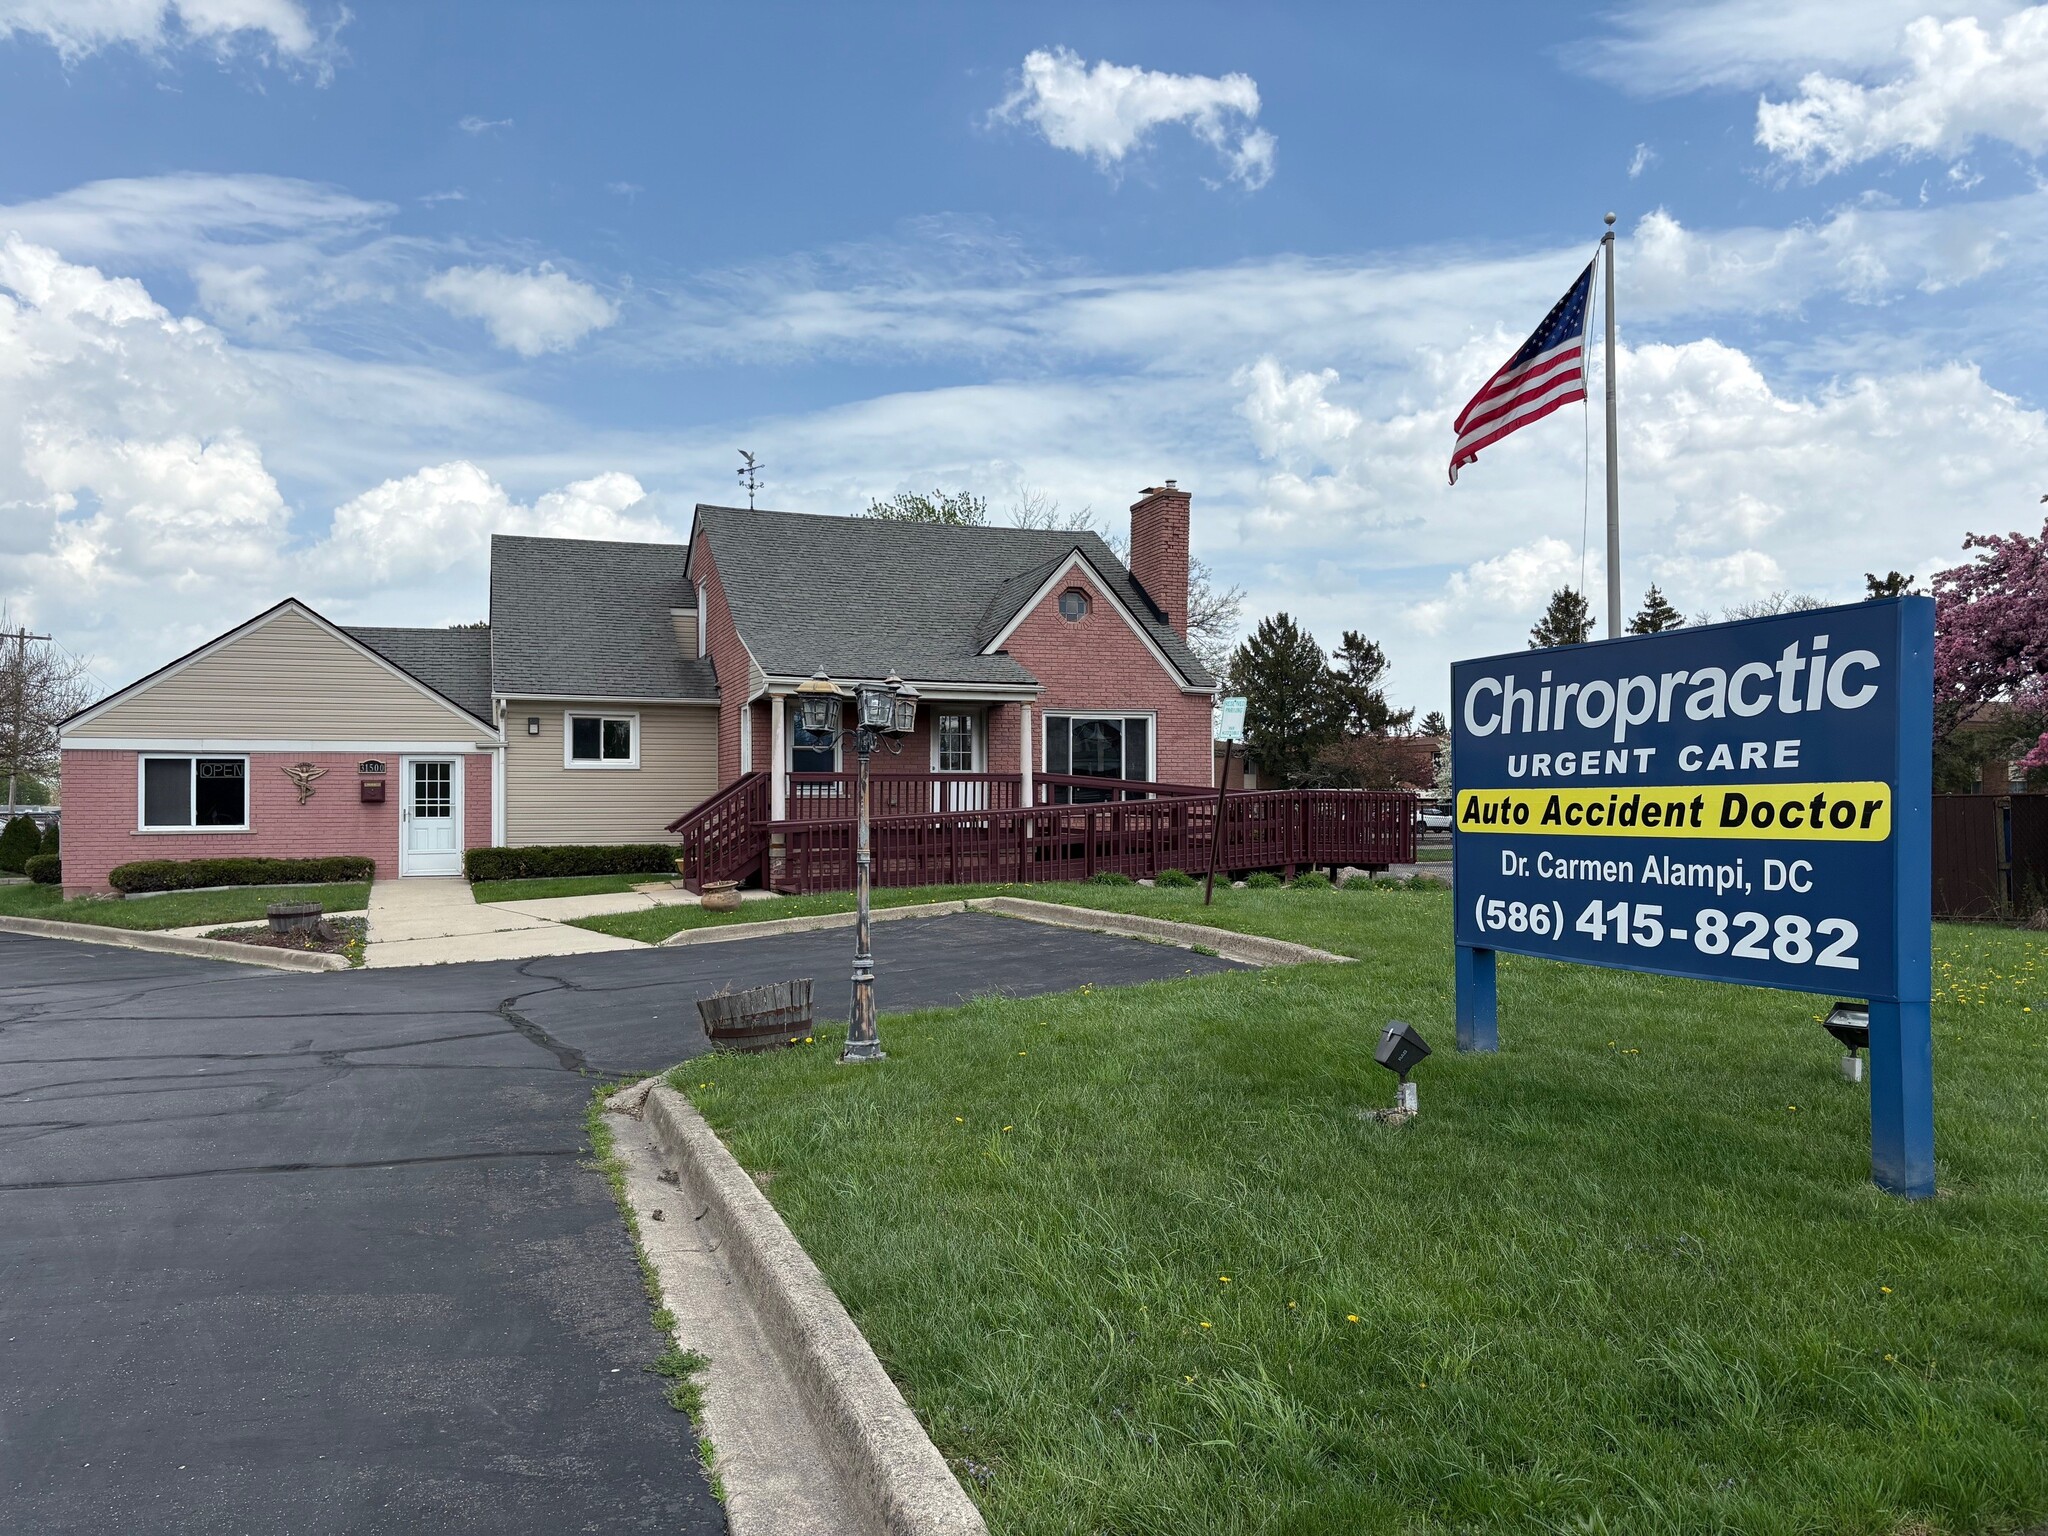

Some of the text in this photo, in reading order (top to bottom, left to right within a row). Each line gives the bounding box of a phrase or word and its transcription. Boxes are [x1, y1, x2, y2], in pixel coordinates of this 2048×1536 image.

[1463, 634, 1881, 744] Chiropractic
[202, 764, 244, 777] OPEN
[360, 763, 385, 772] 31500
[1507, 739, 1801, 778] URGENT CARE
[1461, 791, 1884, 830] Auto Accident Doctor
[1501, 849, 1814, 896] Dr. Carmen Alampi, DC
[1475, 894, 1860, 970] (586) 415-8282
